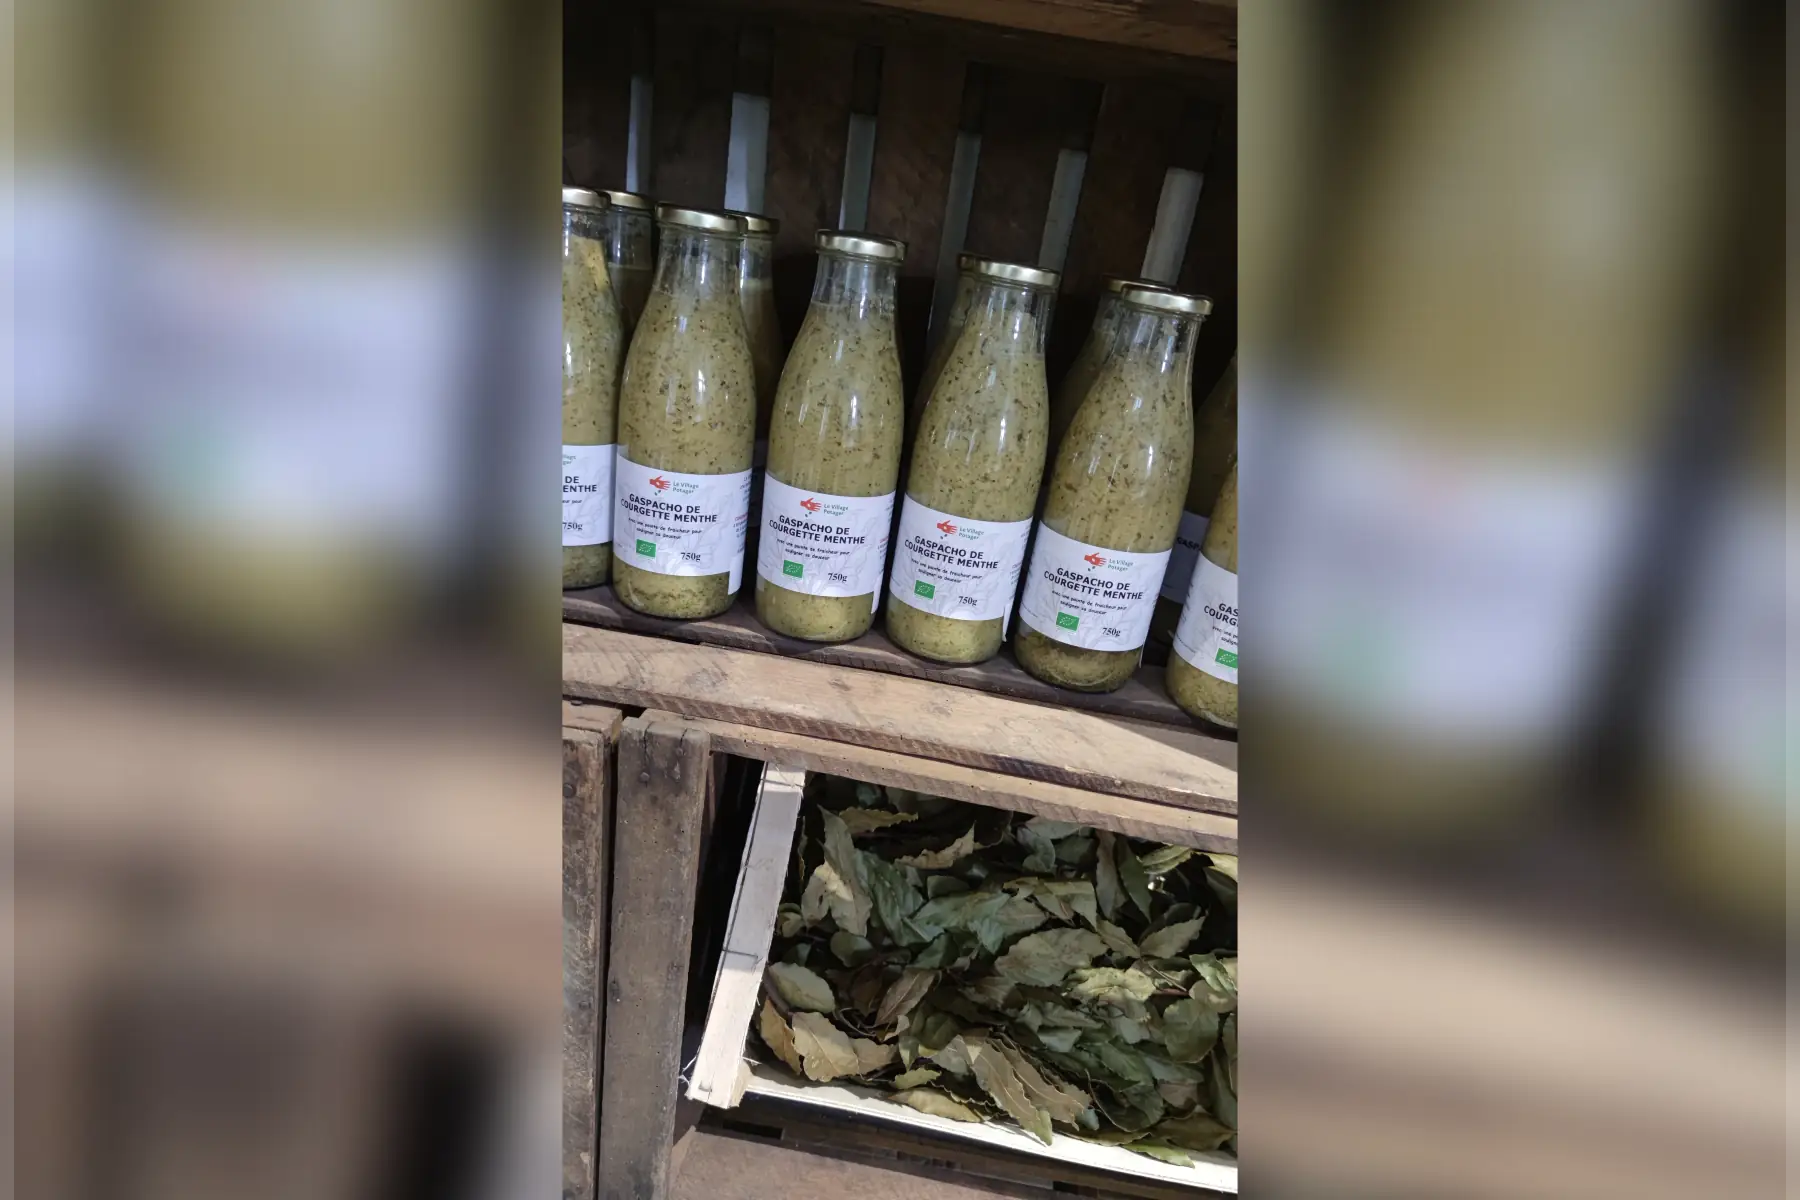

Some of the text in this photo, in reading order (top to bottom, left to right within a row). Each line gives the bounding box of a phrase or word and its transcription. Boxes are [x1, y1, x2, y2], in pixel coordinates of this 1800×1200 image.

[562, 484, 597, 492] ENTHE
[620, 498, 717, 522] COURGETTE MENTHE
[630, 494, 700, 514] GASPACHO DE
[563, 522, 582, 531] 750g
[769, 519, 865, 544] COURGETTE MENTHE
[779, 515, 850, 535] GASPACHO DE
[915, 536, 984, 559] GASPACHO DE
[1176, 536, 1200, 551] GASP
[680, 552, 701, 561] 750g
[904, 540, 953, 564] COURGETTE
[957, 559, 998, 569] MENTHE
[828, 572, 848, 582] 750g
[1044, 570, 1144, 600] COURGETTE MENTHE
[1057, 568, 1114, 589] GASPACHO
[958, 596, 978, 606] 750g
[1219, 603, 1238, 616] GAS
[1204, 606, 1238, 626] COURG
[1102, 627, 1121, 637] 750g
